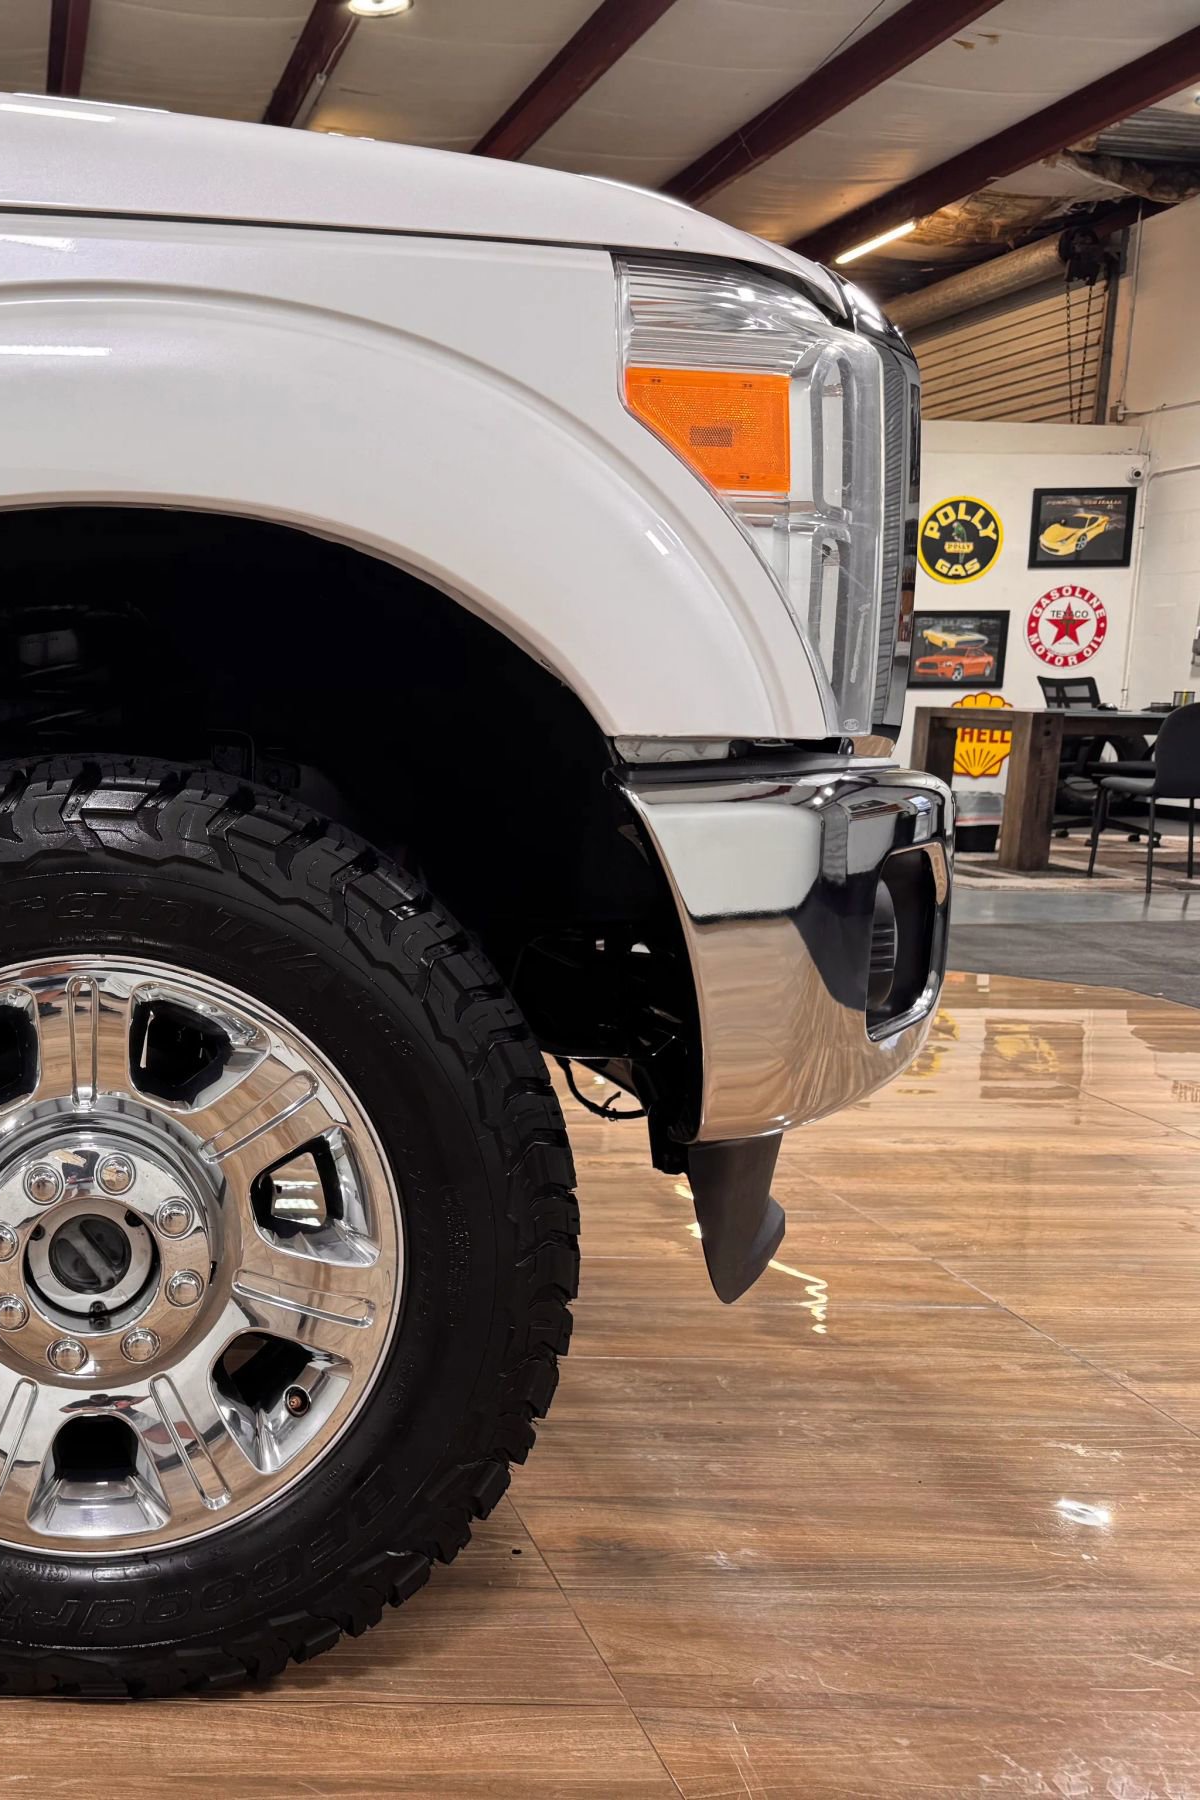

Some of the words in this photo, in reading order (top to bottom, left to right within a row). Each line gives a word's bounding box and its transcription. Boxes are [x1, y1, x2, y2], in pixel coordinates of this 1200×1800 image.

[924, 502, 998, 541] POLLY
[934, 558, 981, 577] GAS
[1032, 586, 1106, 619] GASOLINE
[1029, 633, 1078, 666] MOTOR
[1083, 635, 1104, 658] OIL
[960, 728, 1010, 743] HELL
